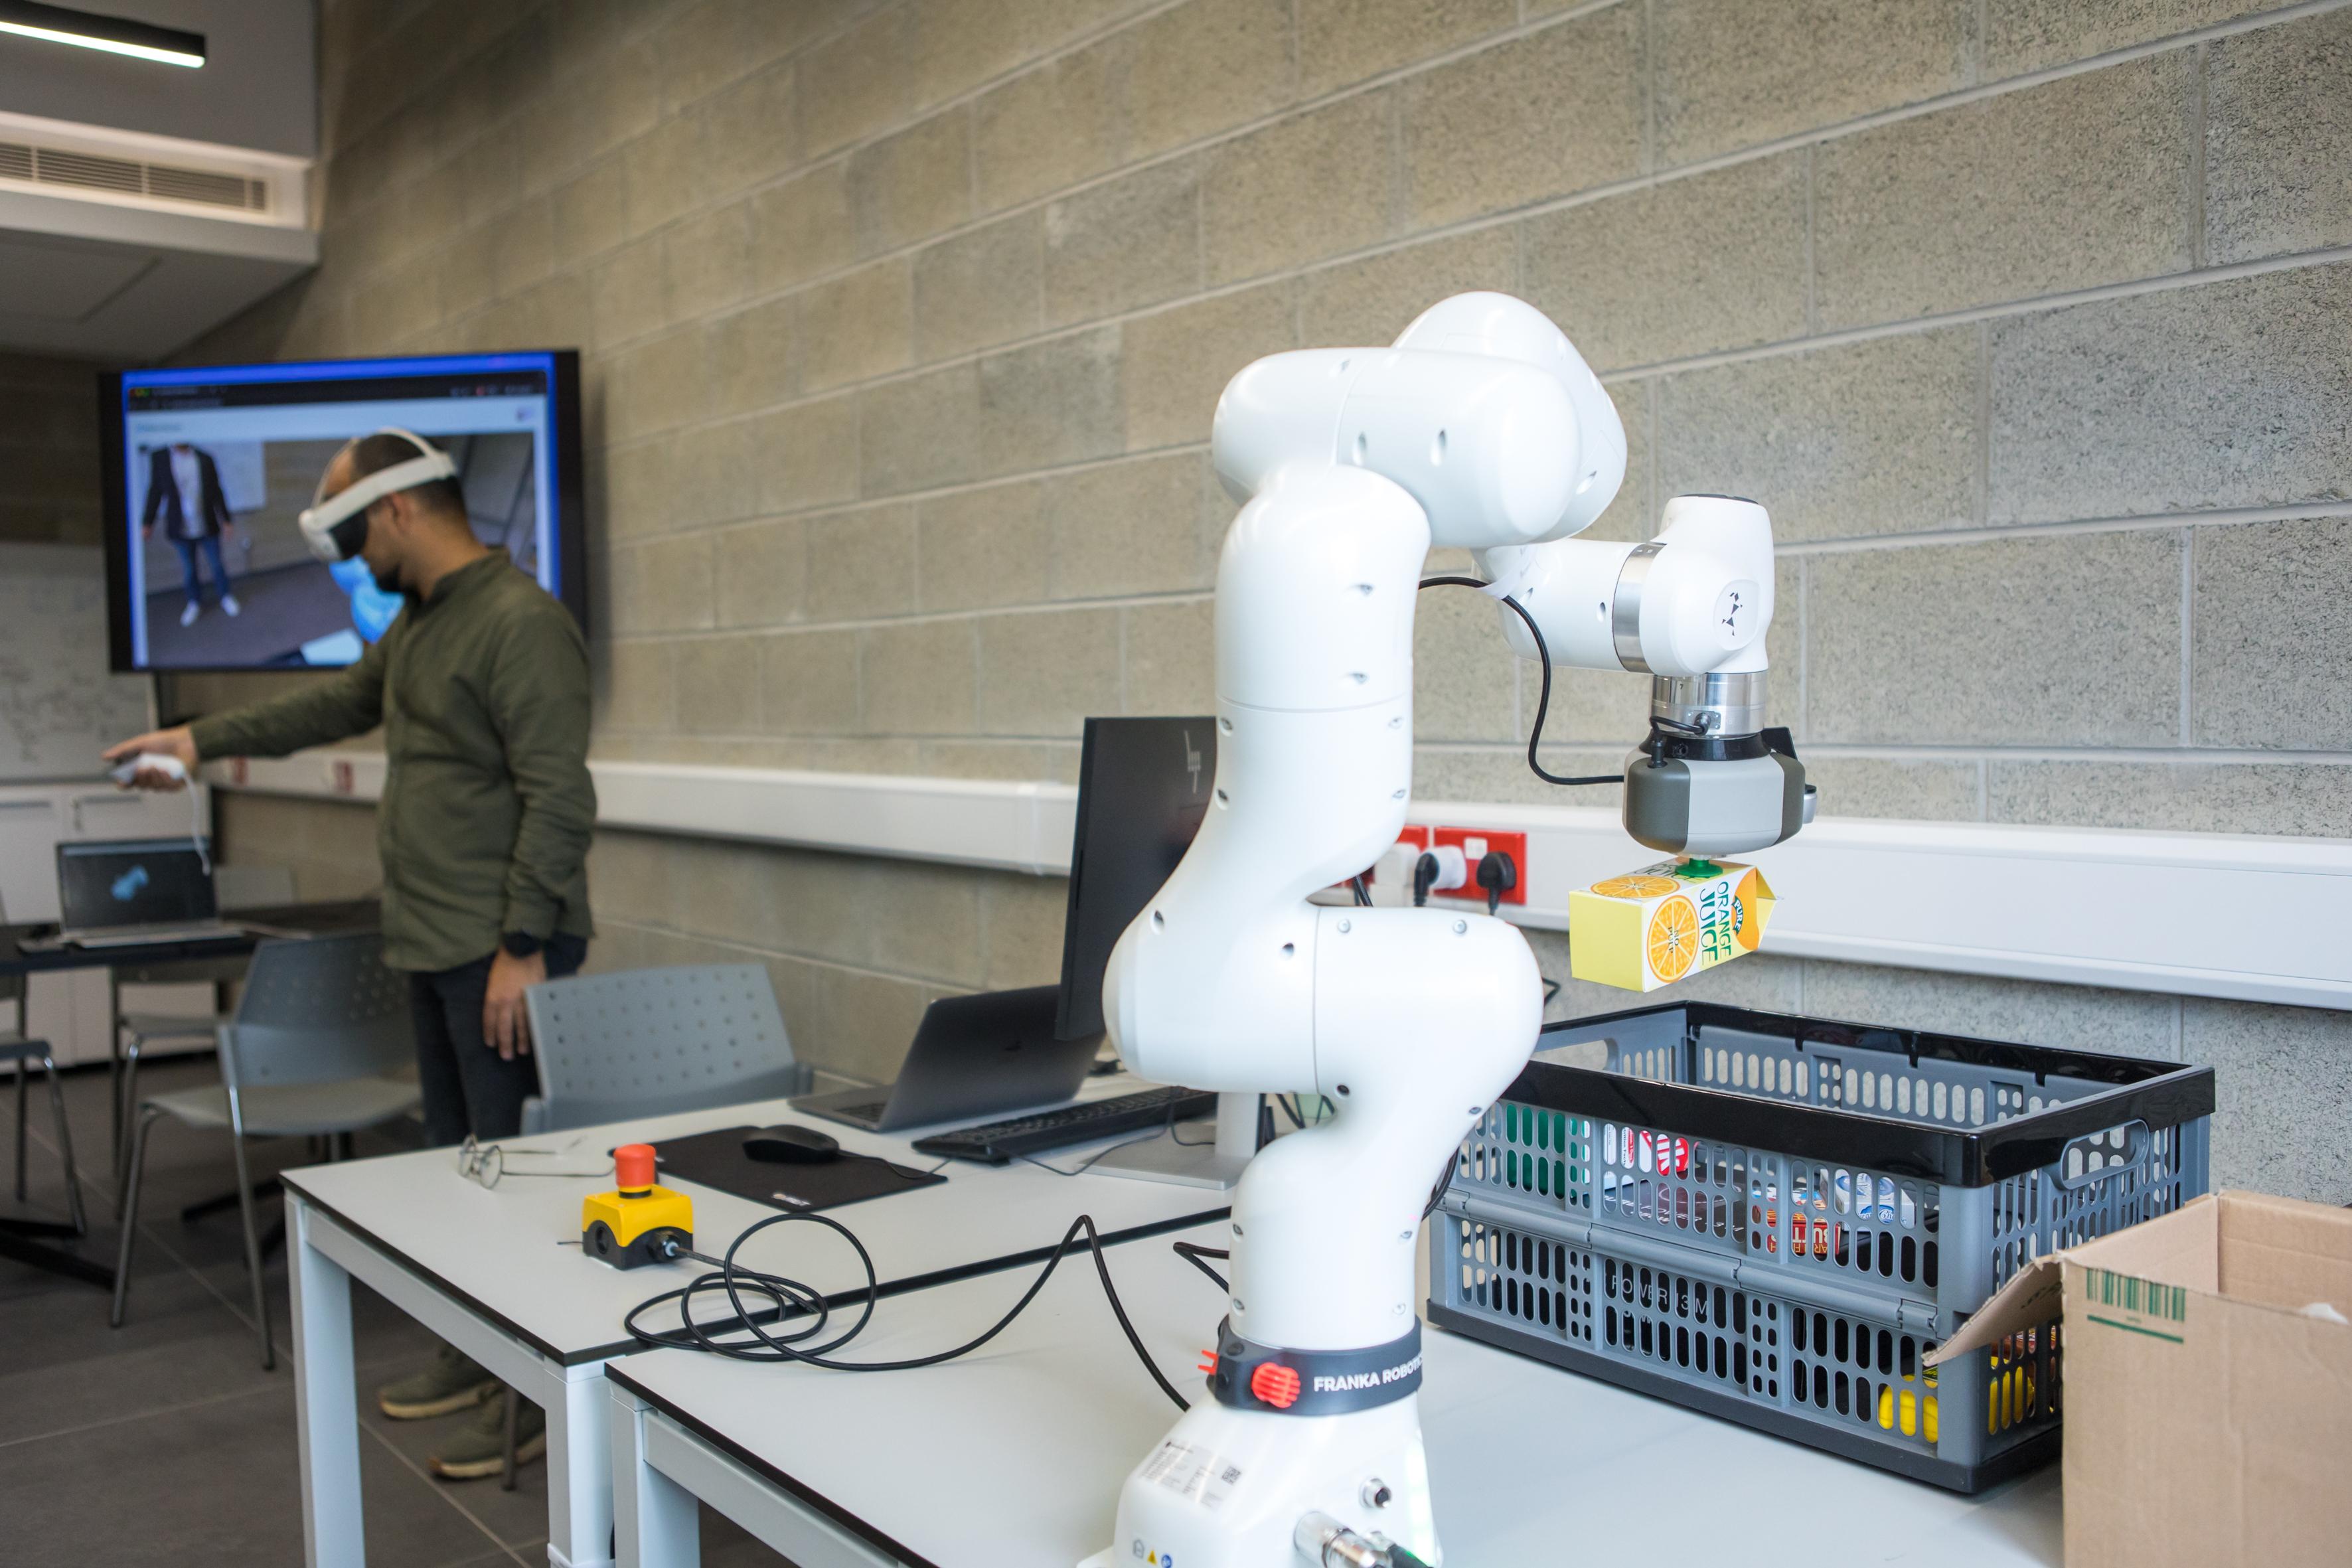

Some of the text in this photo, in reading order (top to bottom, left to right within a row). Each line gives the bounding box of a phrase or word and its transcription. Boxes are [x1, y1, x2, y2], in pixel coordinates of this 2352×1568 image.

[1699, 888, 1718, 966] JUICE
[1717, 881, 1732, 959] ORANGE
[1733, 898, 1743, 932] PURE
[1674, 929, 1680, 947] NO
[1313, 1372, 1381, 1392] FRANKA
